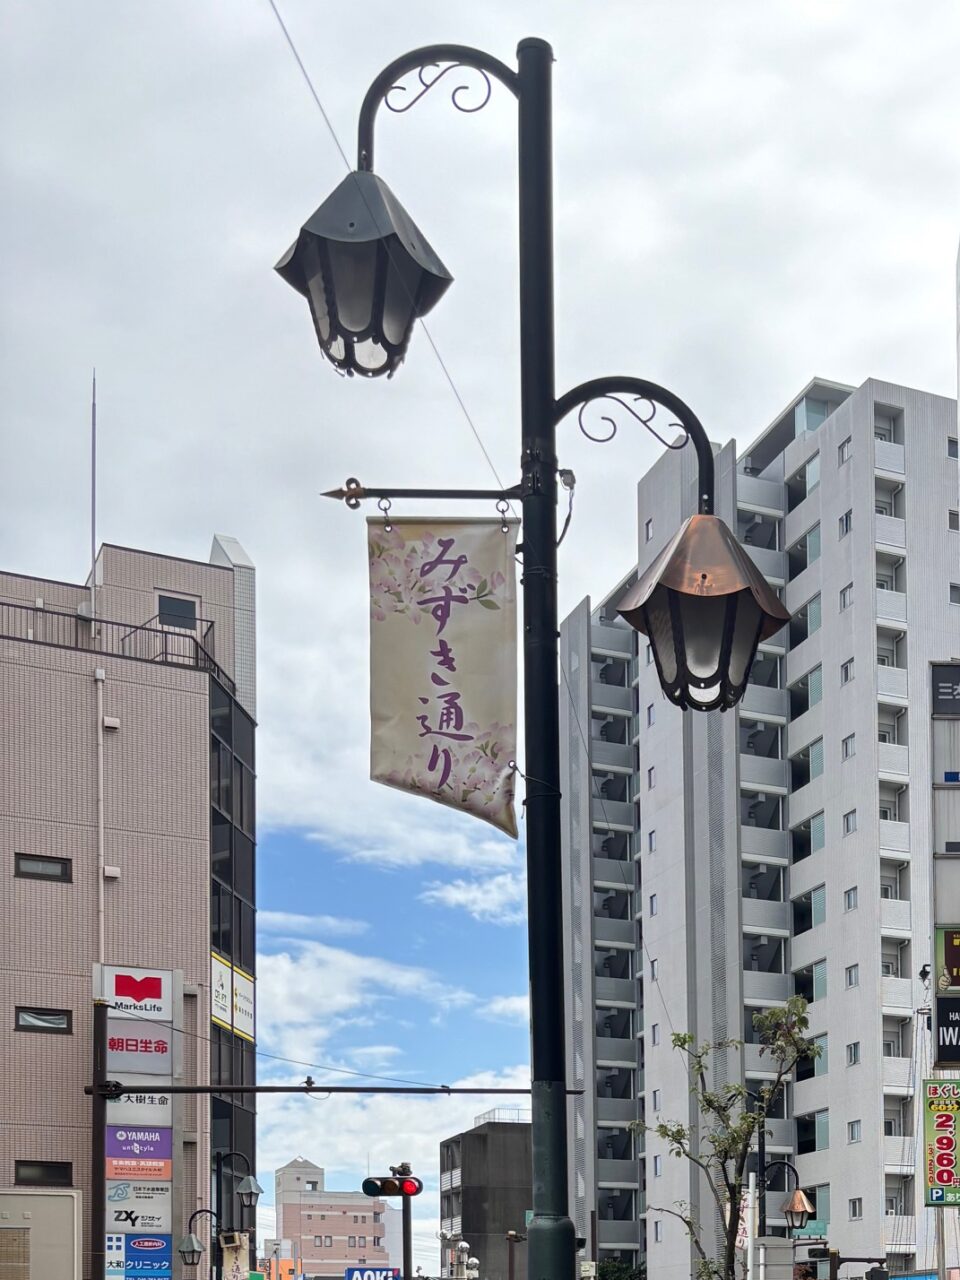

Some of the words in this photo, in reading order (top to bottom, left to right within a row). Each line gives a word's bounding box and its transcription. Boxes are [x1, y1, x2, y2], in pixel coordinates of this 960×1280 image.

[416, 538, 474, 789] みずき通り
[114, 1002, 162, 1012] MarksLife
[108, 1037, 168, 1054] 朝日生命
[928, 1084, 960, 1097] ほぐし
[123, 1094, 169, 1106] 大樹生命
[127, 1132, 161, 1141] YAMAHA
[932, 1189, 943, 1200] P
